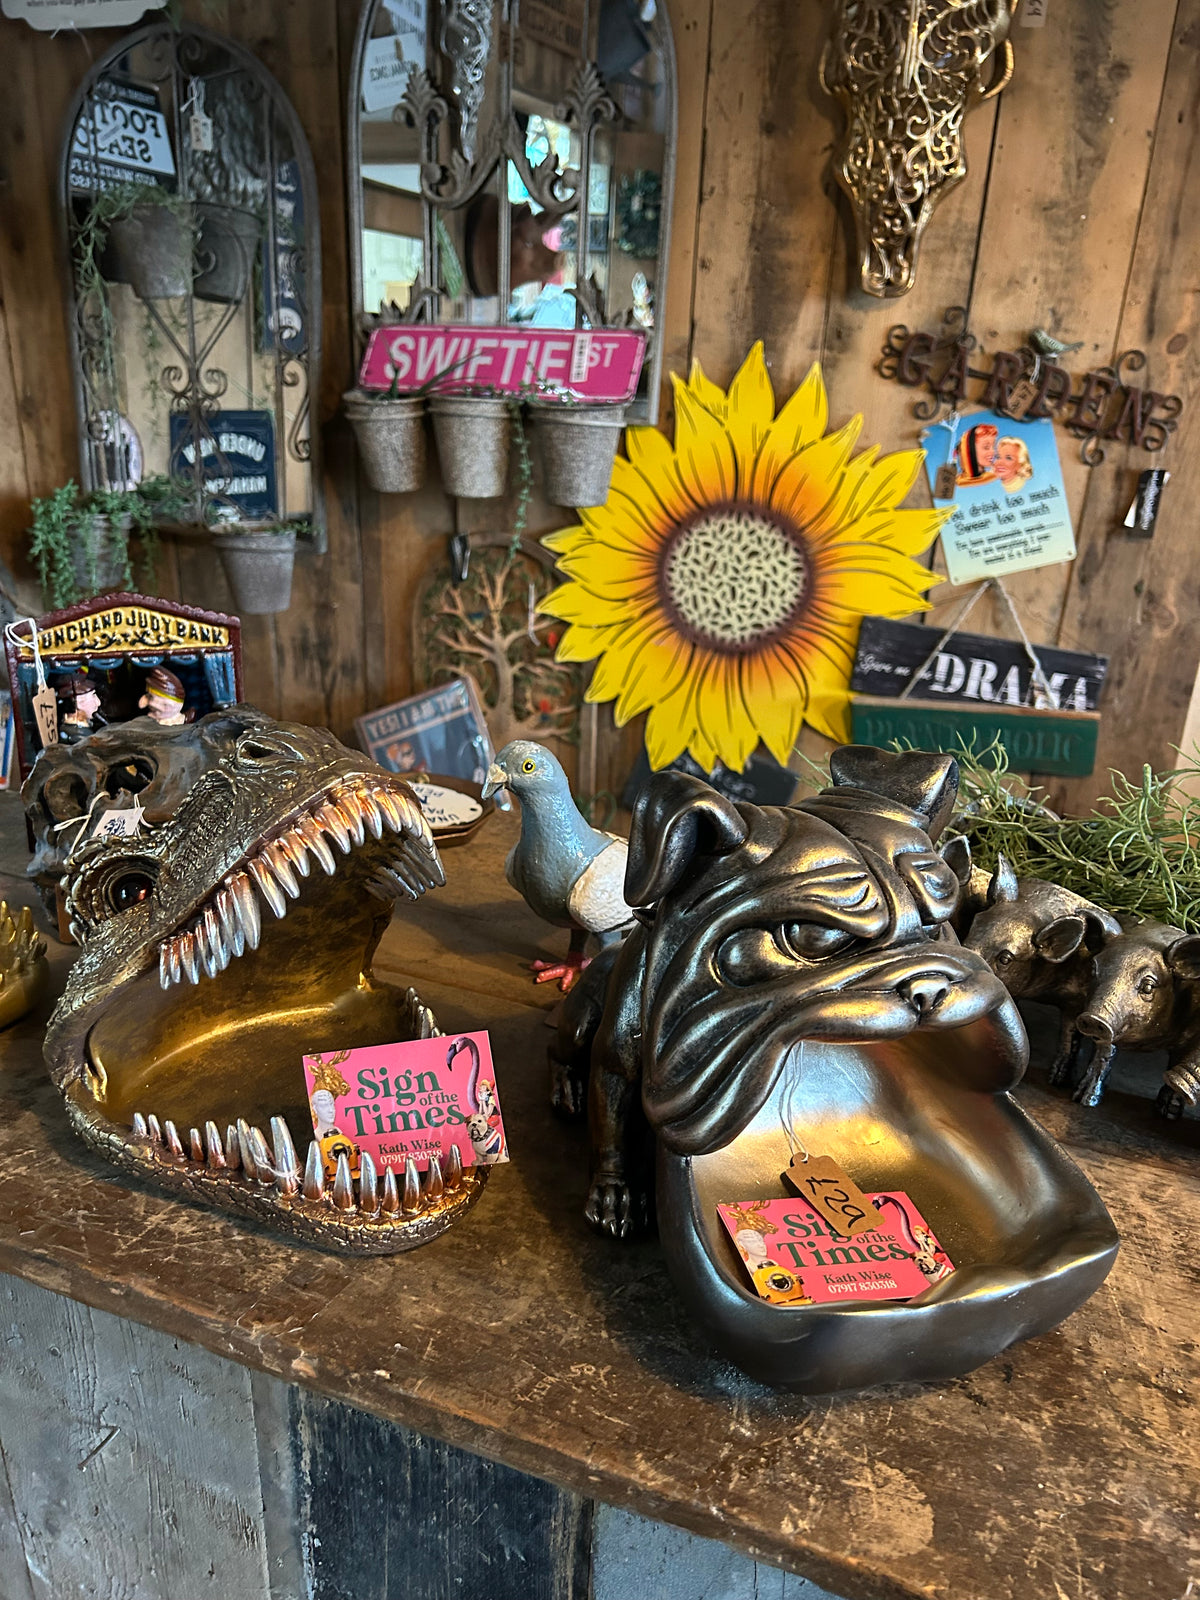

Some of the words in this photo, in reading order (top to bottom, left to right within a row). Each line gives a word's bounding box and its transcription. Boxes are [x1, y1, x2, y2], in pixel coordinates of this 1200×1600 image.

[383, 335, 571, 386] SWIFTIE
[586, 342, 620, 368] ST
[897, 332, 1166, 447] GARDEN
[969, 499, 1001, 517] drink
[1005, 495, 1025, 508] too
[1029, 484, 1060, 502] much
[954, 518, 991, 535] Swear
[996, 512, 1016, 525] too
[1020, 502, 1051, 520] much
[38, 621, 92, 649] UNCH
[126, 610, 171, 635] JUDY
[176, 622, 224, 645] BANK
[39, 702, 58, 743] £35
[357, 1067, 443, 1106] Sign
[419, 1093, 435, 1106] of
[436, 1092, 458, 1104] the
[344, 1103, 467, 1137] Times
[378, 1142, 409, 1155] Kath
[410, 1139, 442, 1150] Wise
[380, 1153, 407, 1165] 07917
[805, 1176, 866, 1229] £29
[782, 1213, 877, 1244] Sig
[856, 1233, 871, 1244] of
[871, 1232, 897, 1243] the
[776, 1241, 912, 1268] Times
[823, 1272, 857, 1285] Kath
[858, 1270, 893, 1283] Wise
[827, 1282, 858, 1295] 07917
[860, 1279, 898, 1292] 830318
